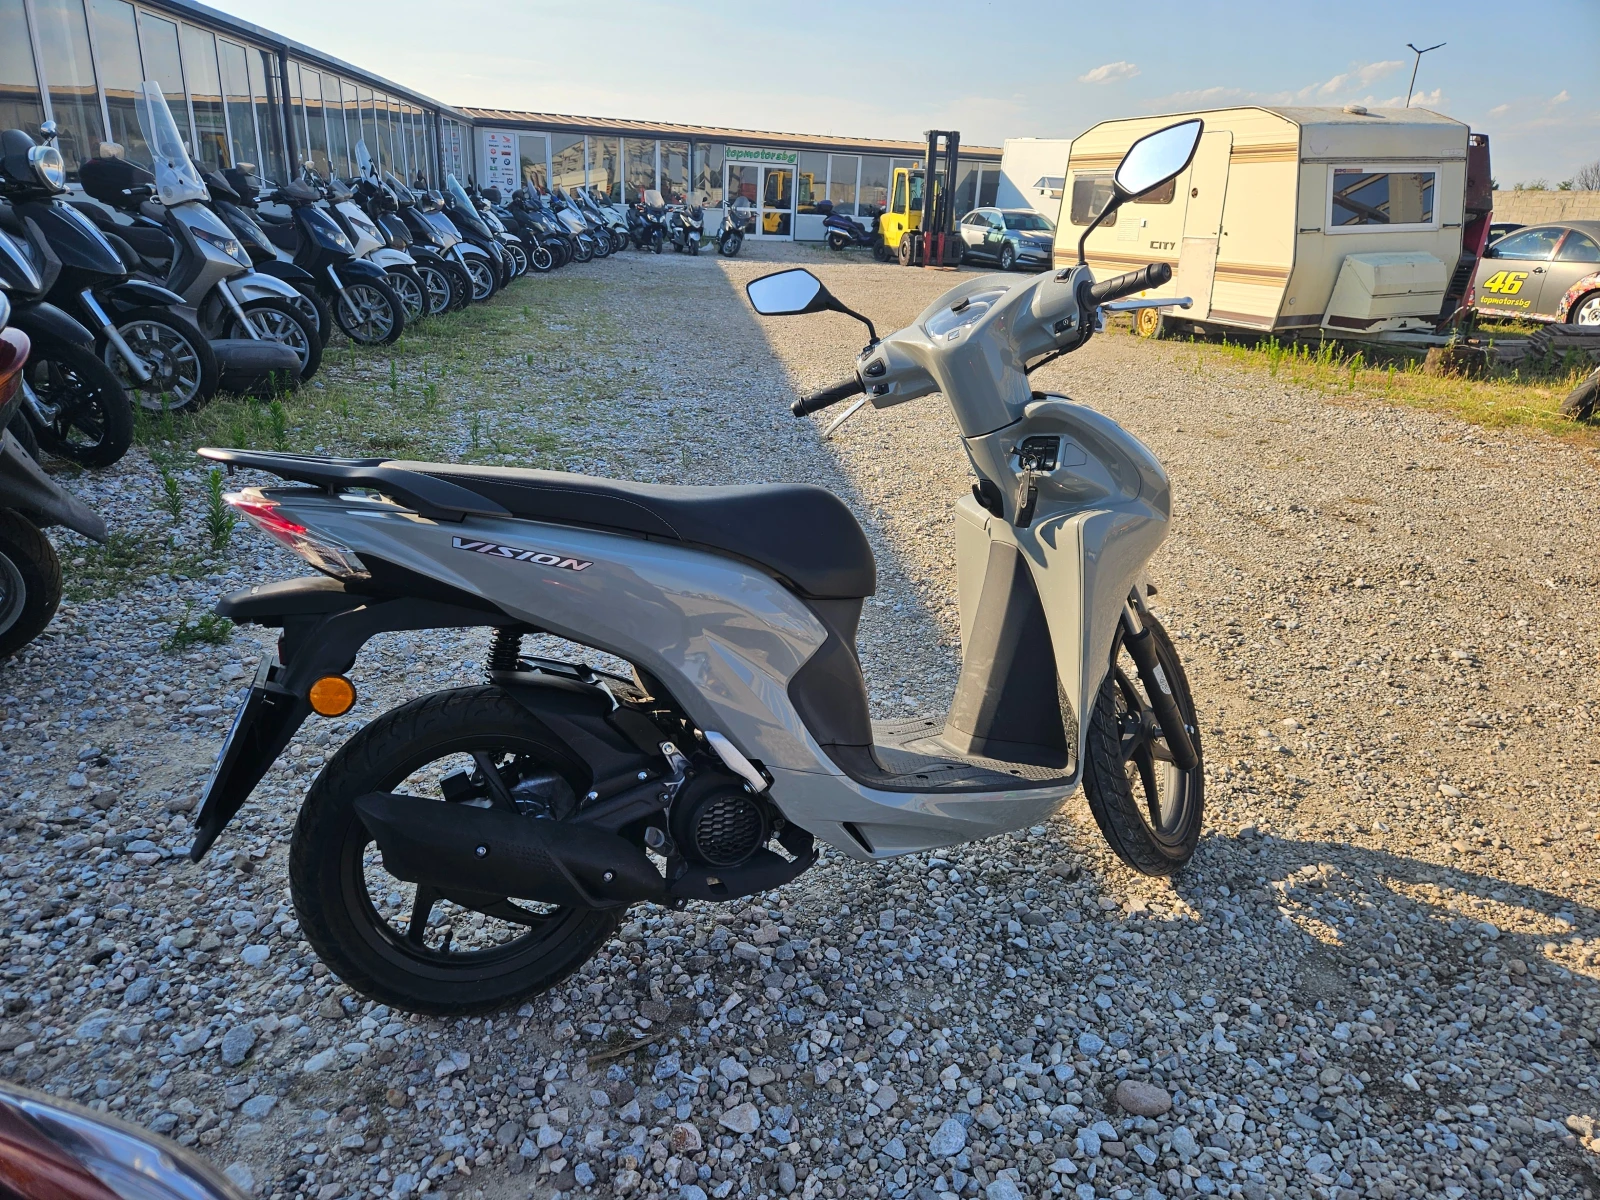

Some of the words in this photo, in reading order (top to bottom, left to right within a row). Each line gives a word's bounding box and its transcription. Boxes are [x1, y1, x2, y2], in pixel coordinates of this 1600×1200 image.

[726, 147, 797, 164] topmotorsbg
[1149, 240, 1176, 251] CITY
[1482, 270, 1529, 295] 46
[1480, 295, 1531, 308] topmotorsbg
[452, 536, 595, 571] VISION
